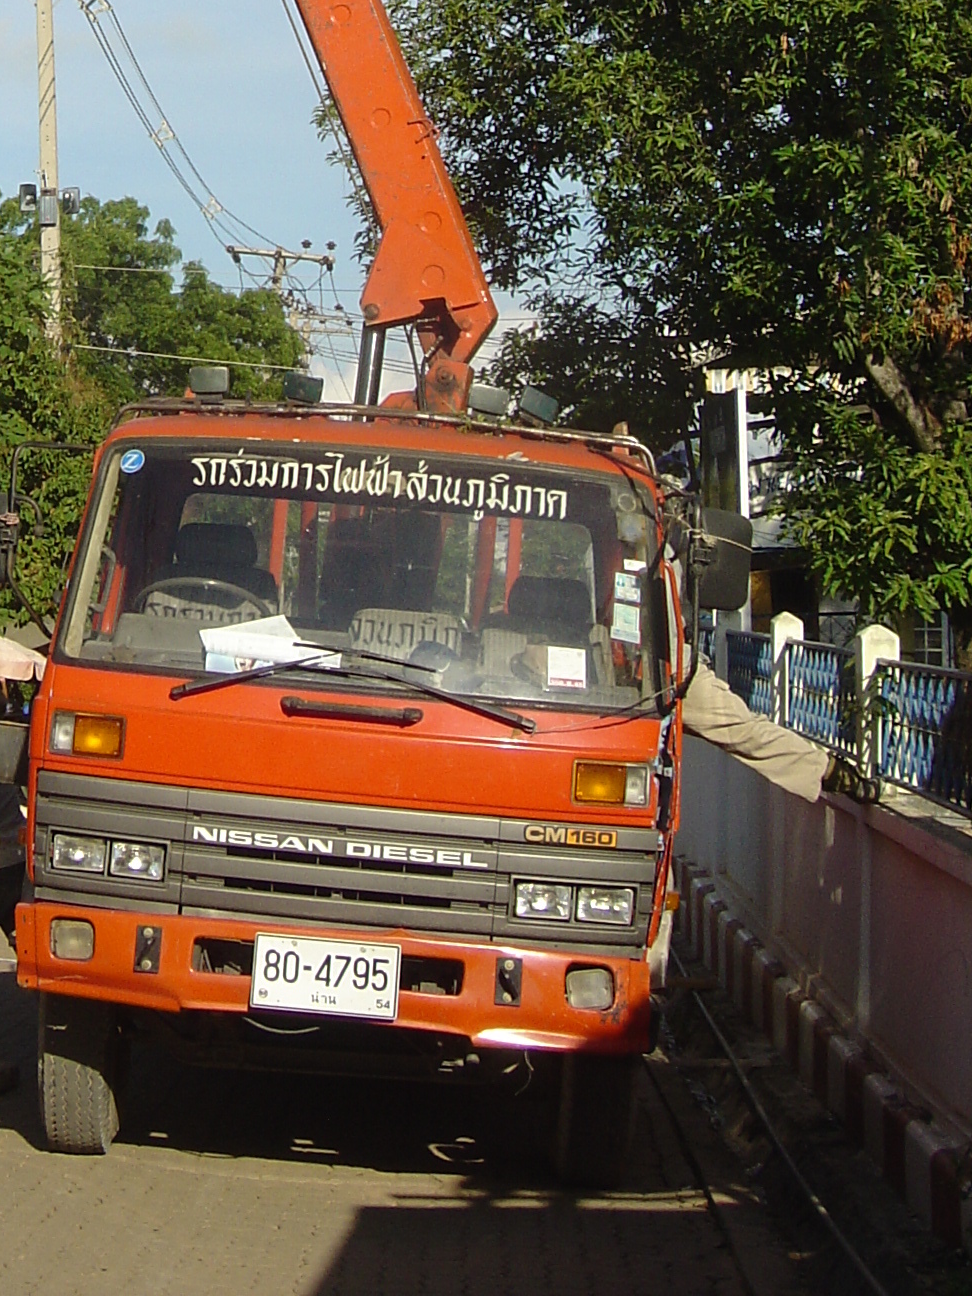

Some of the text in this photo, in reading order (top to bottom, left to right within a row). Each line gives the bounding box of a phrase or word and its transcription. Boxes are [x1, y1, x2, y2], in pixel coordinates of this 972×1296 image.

[191, 448, 568, 521] รถร่วมการไฟฟ้าส่วนภูมิภาค
[192, 825, 489, 868] NISSAN DIESEL
[523, 824, 618, 848] CM160
[263, 948, 391, 992] 80-4795
[310, 991, 337, 1005] น่าน
[375, 998, 391, 1010] 54
